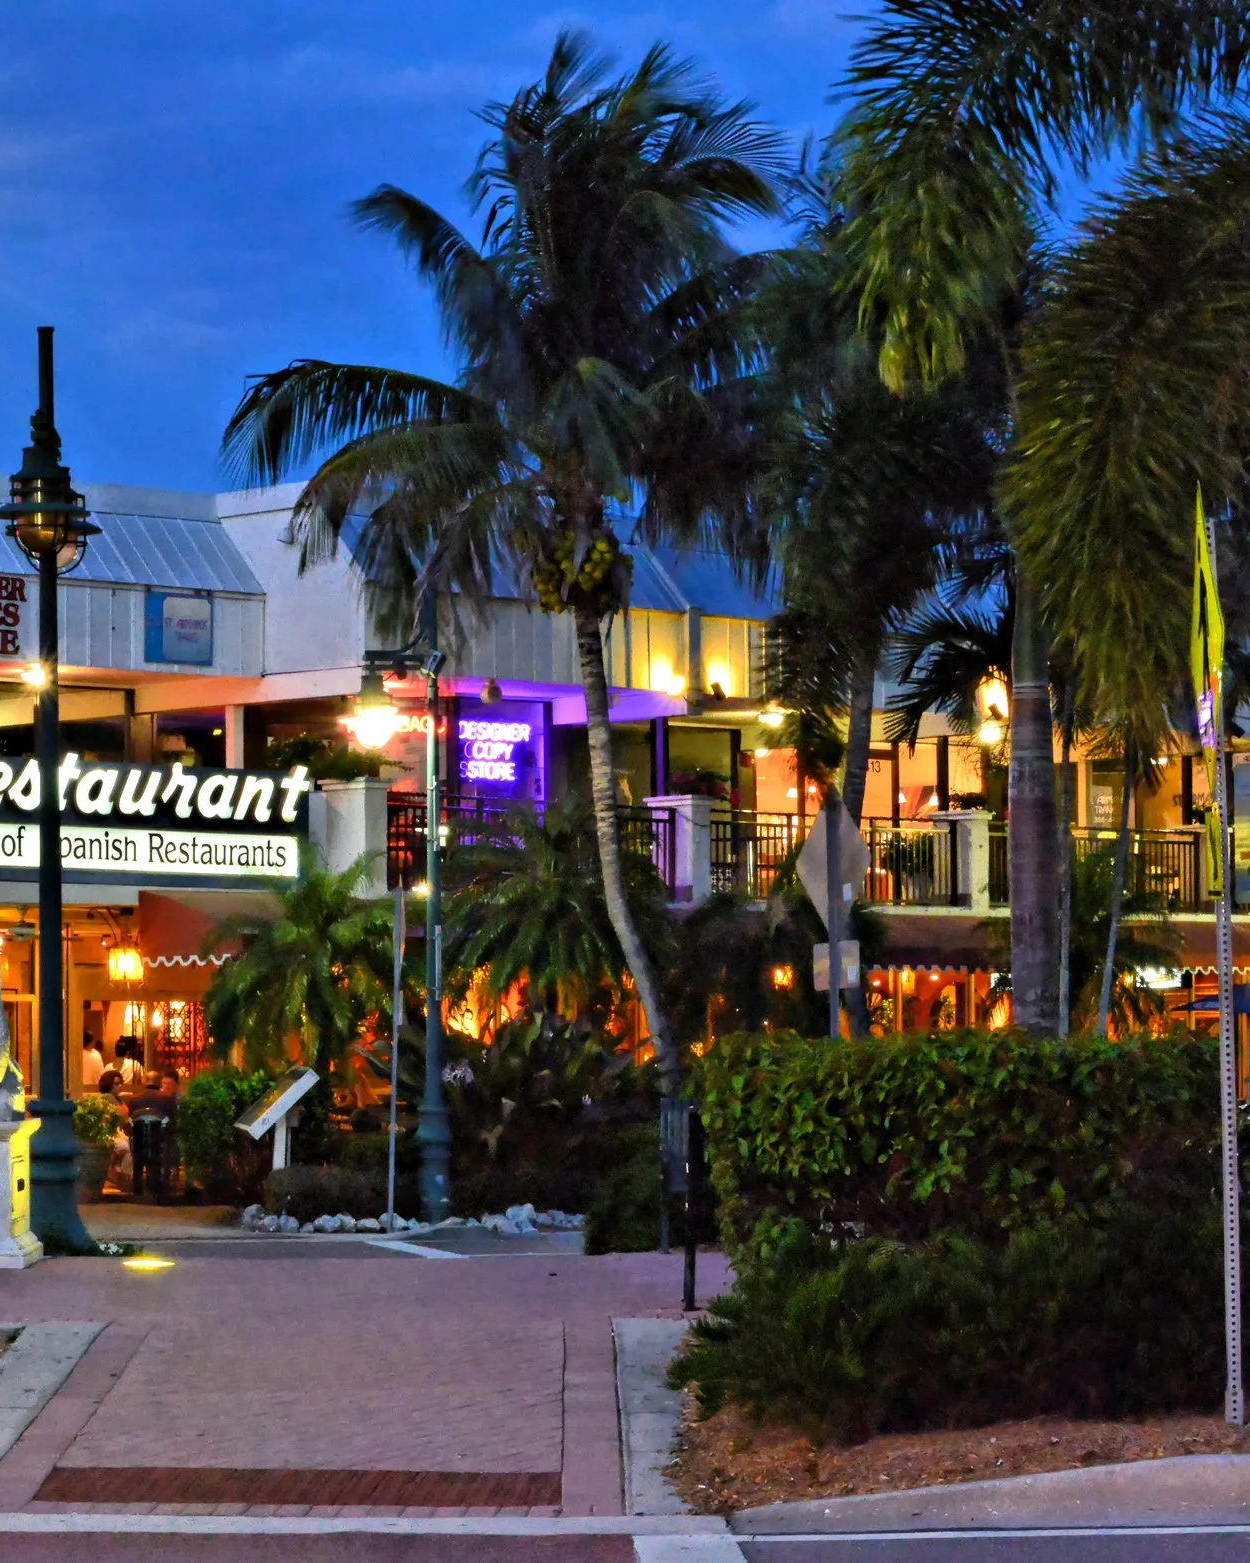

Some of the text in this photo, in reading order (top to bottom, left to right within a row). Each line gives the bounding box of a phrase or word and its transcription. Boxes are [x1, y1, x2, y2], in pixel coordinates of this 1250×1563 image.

[458, 720, 531, 742] DESIGNER
[466, 761, 516, 781] STORE
[868, 760, 882, 773] 13
[1, 825, 26, 857] of
[60, 830, 138, 862] panish
[148, 832, 287, 868] Restaurants
